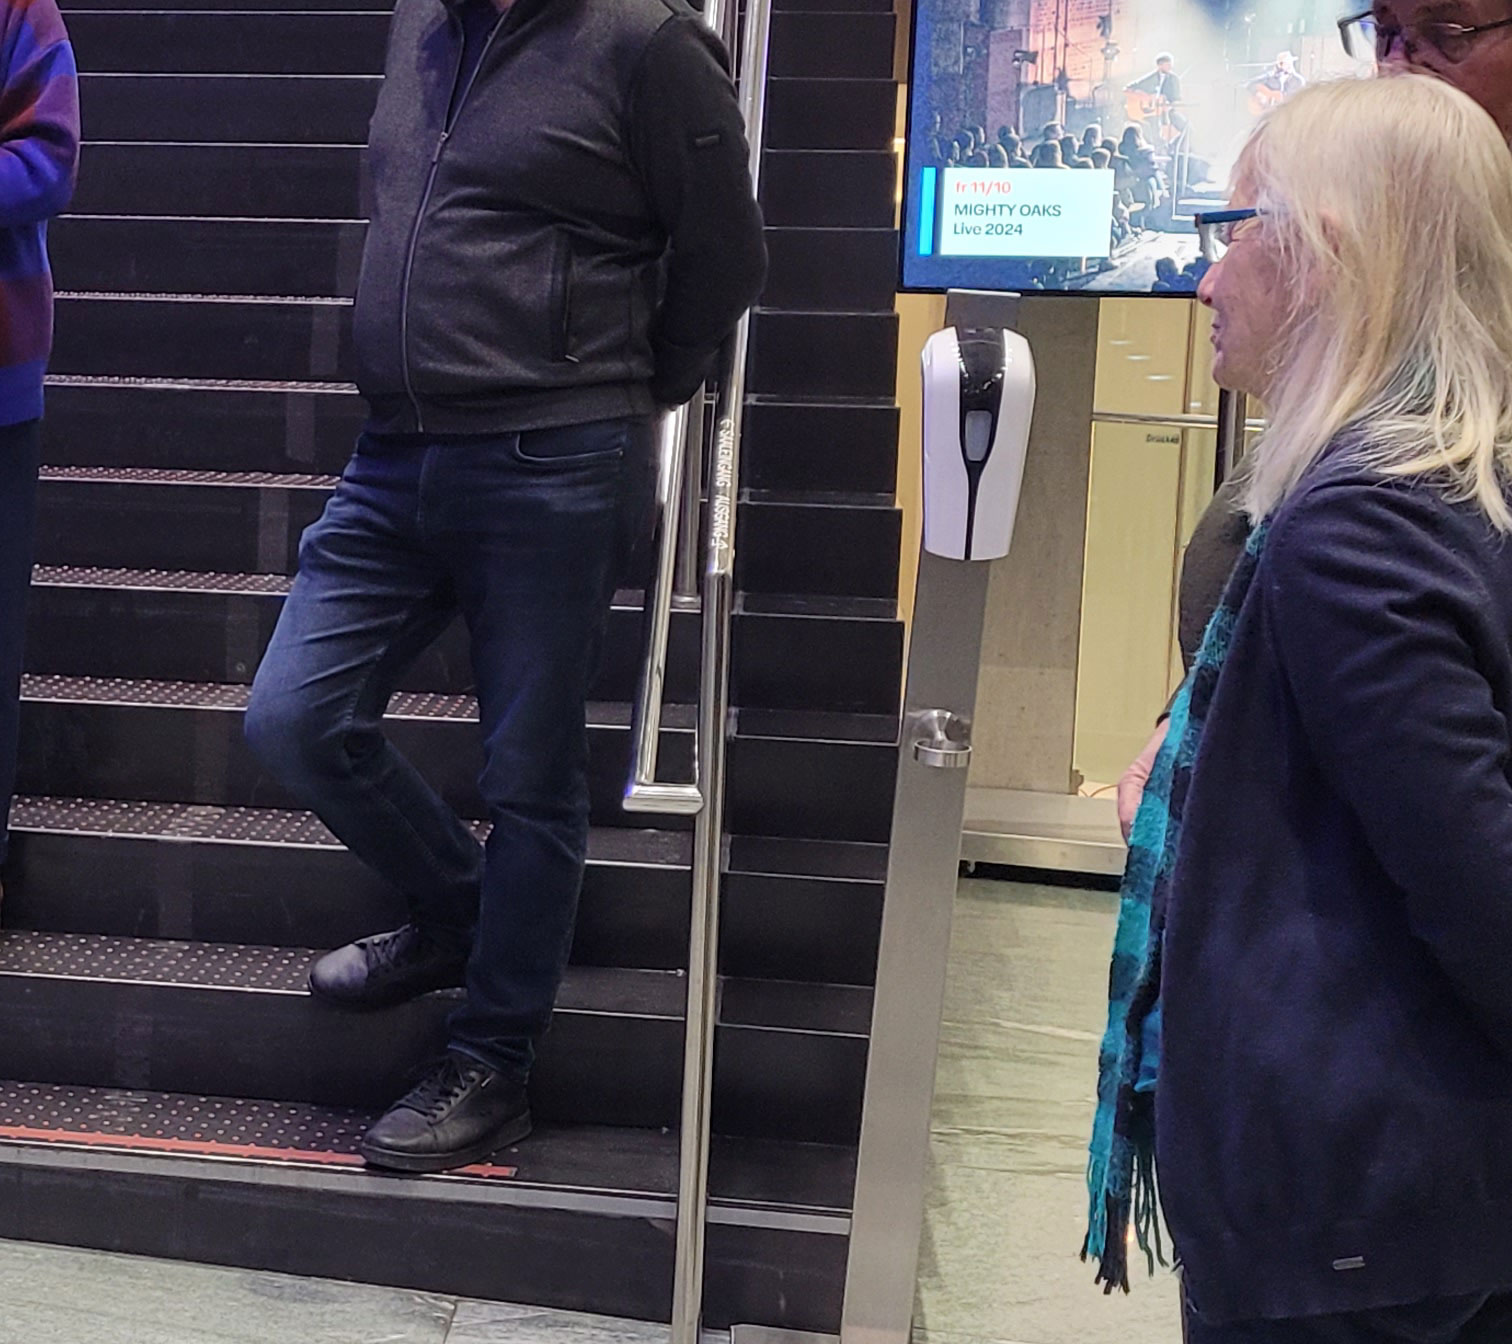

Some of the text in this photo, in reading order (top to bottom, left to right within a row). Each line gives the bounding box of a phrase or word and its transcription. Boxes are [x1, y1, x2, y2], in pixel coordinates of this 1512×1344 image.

[970, 180, 1012, 197] 11/10
[954, 203, 1062, 217] MIGHTY OAKS
[953, 221, 1023, 236] Live 2024
